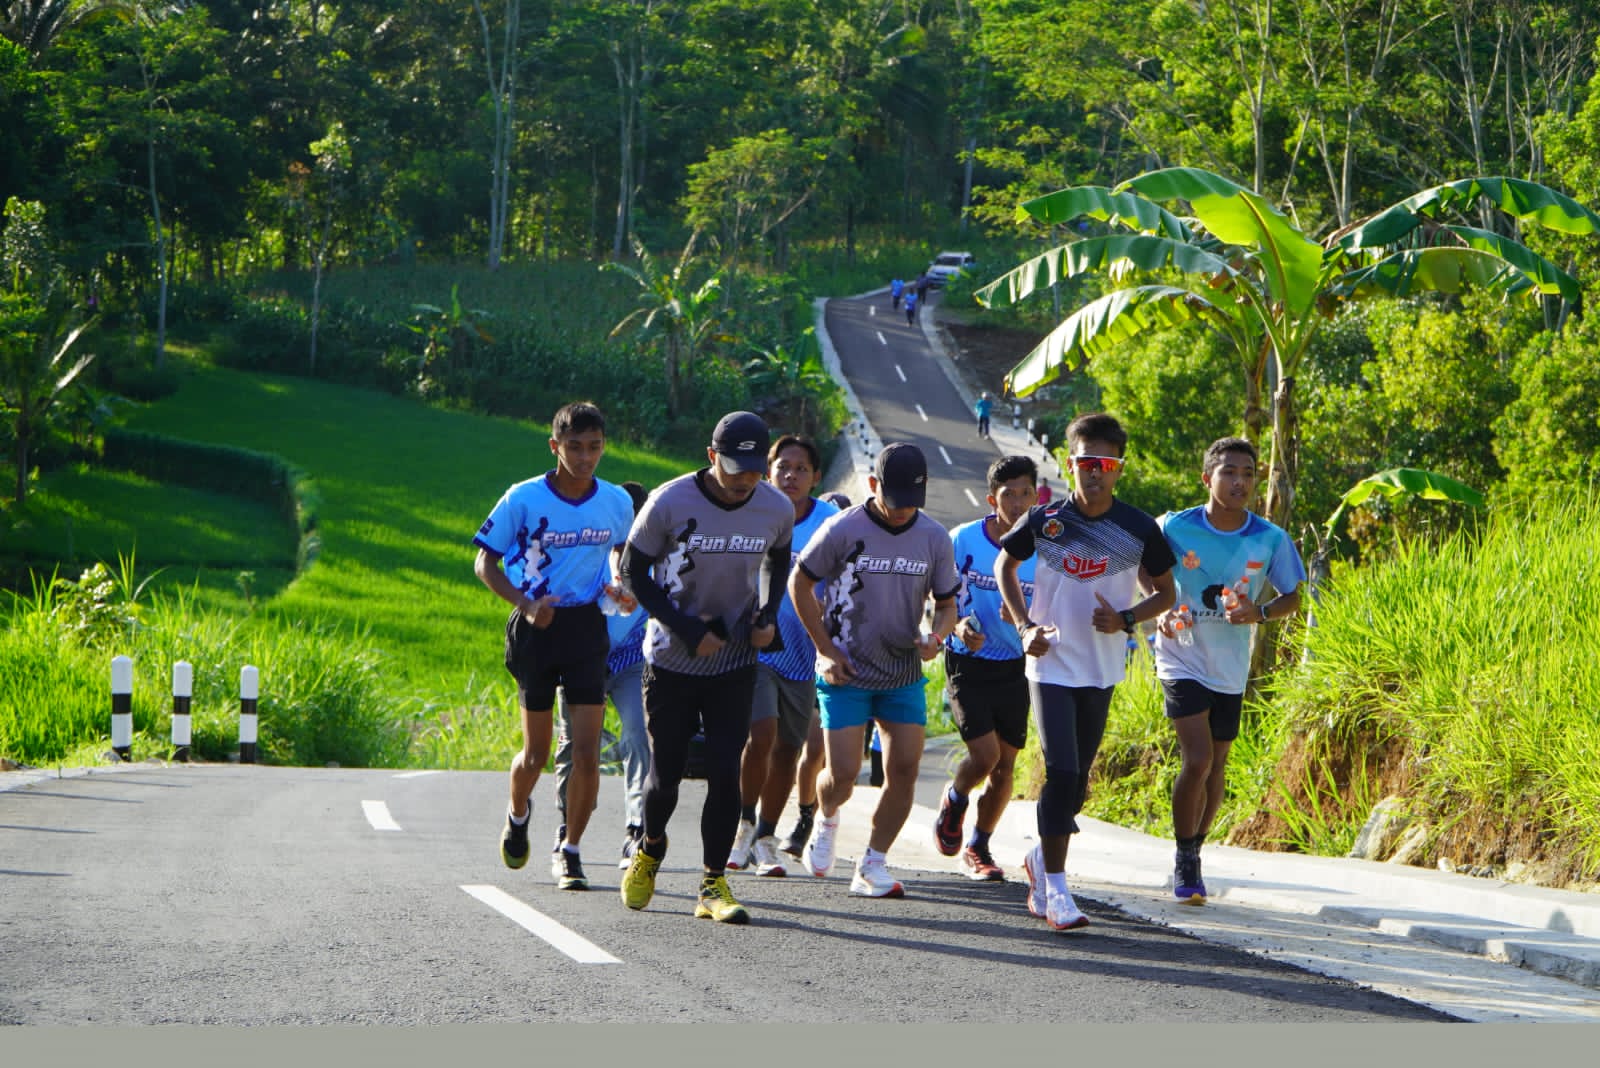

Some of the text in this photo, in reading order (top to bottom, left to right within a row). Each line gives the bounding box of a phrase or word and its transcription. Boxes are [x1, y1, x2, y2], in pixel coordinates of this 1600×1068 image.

[542, 527, 612, 548] Fun Run
[687, 534, 767, 553] Fun Run
[855, 555, 929, 576] Fun Run
